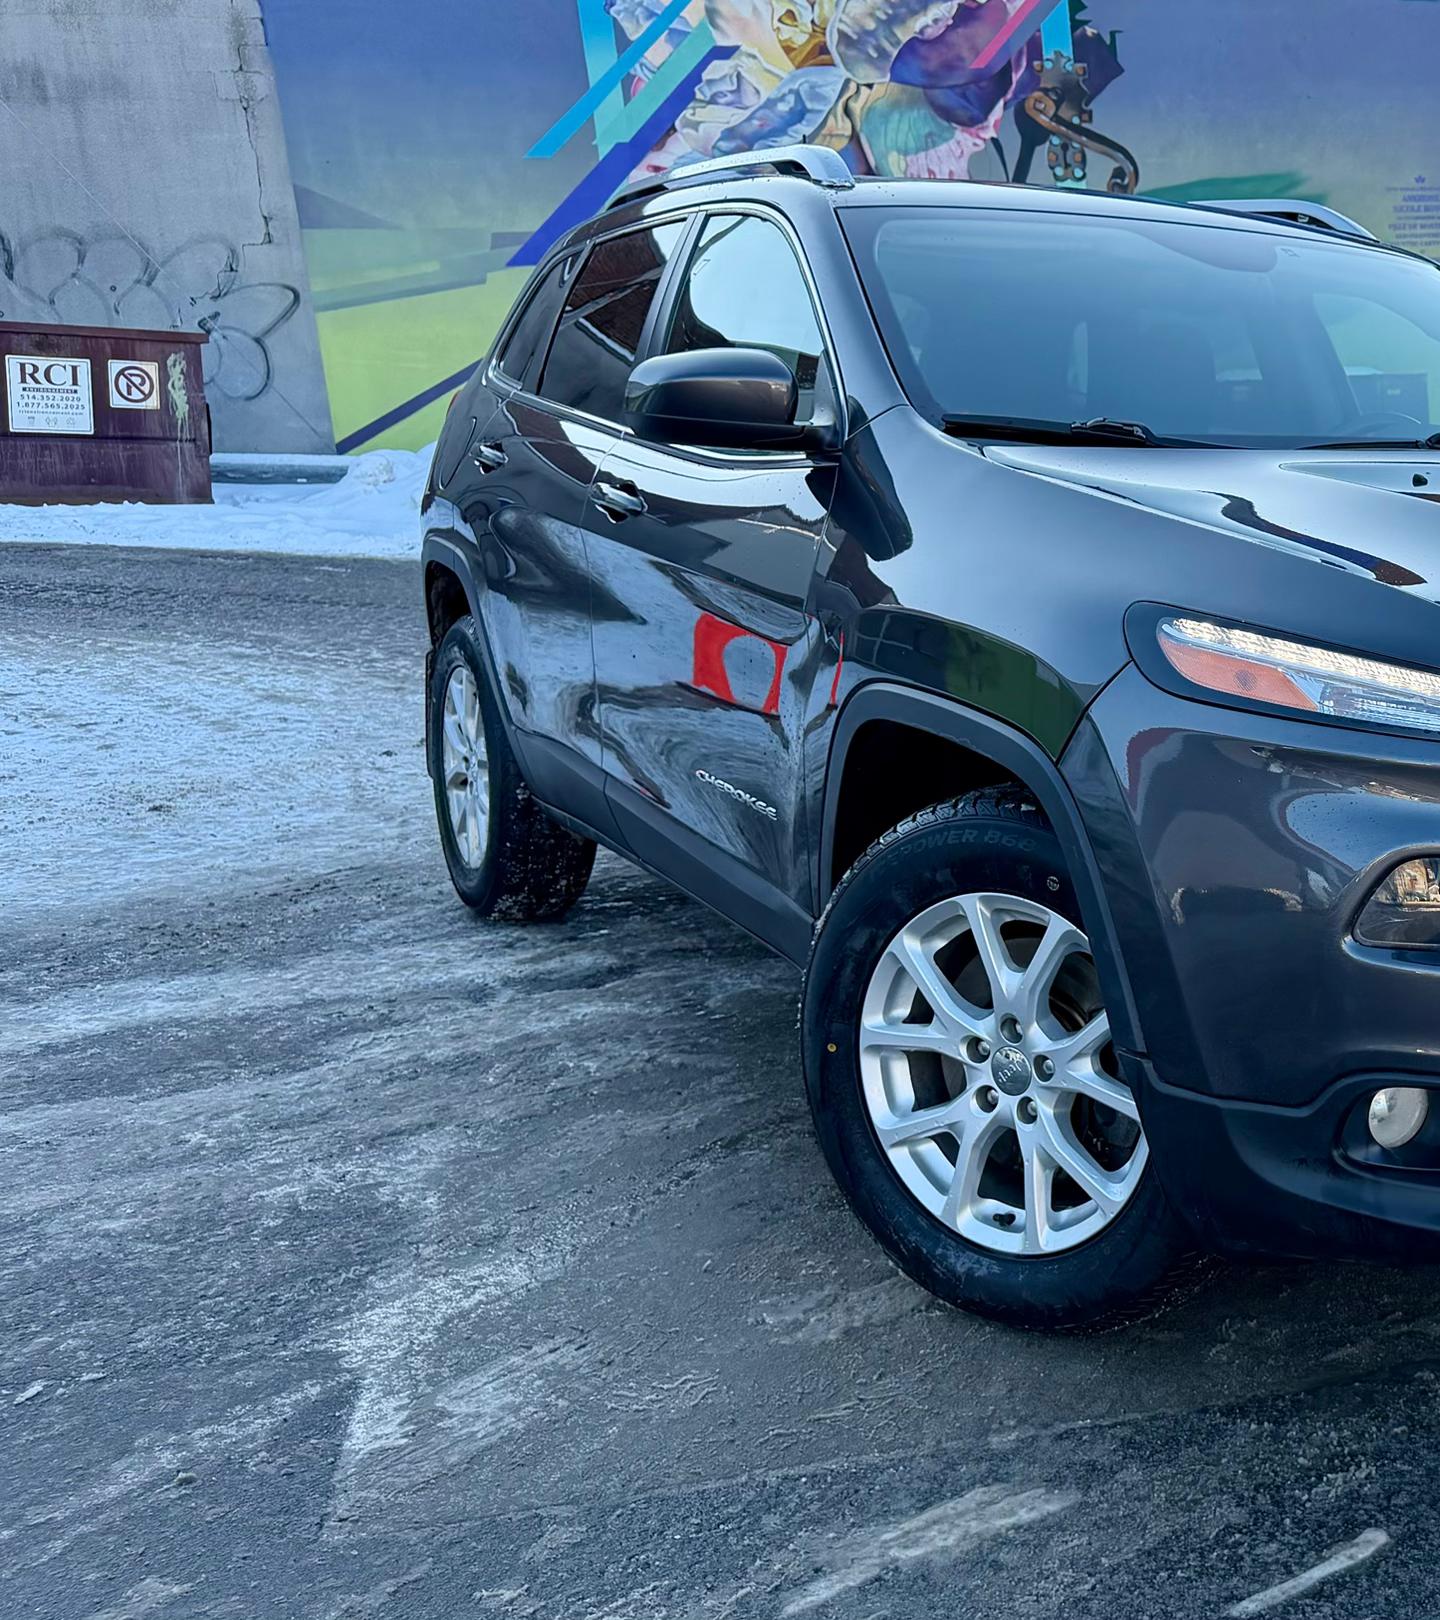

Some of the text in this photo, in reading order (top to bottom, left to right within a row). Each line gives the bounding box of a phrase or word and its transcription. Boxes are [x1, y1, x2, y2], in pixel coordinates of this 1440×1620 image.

[16, 361, 81, 387] RCI
[20, 394, 81, 403] 514.352.2020
[695, 769, 778, 820] CHEROKEE
